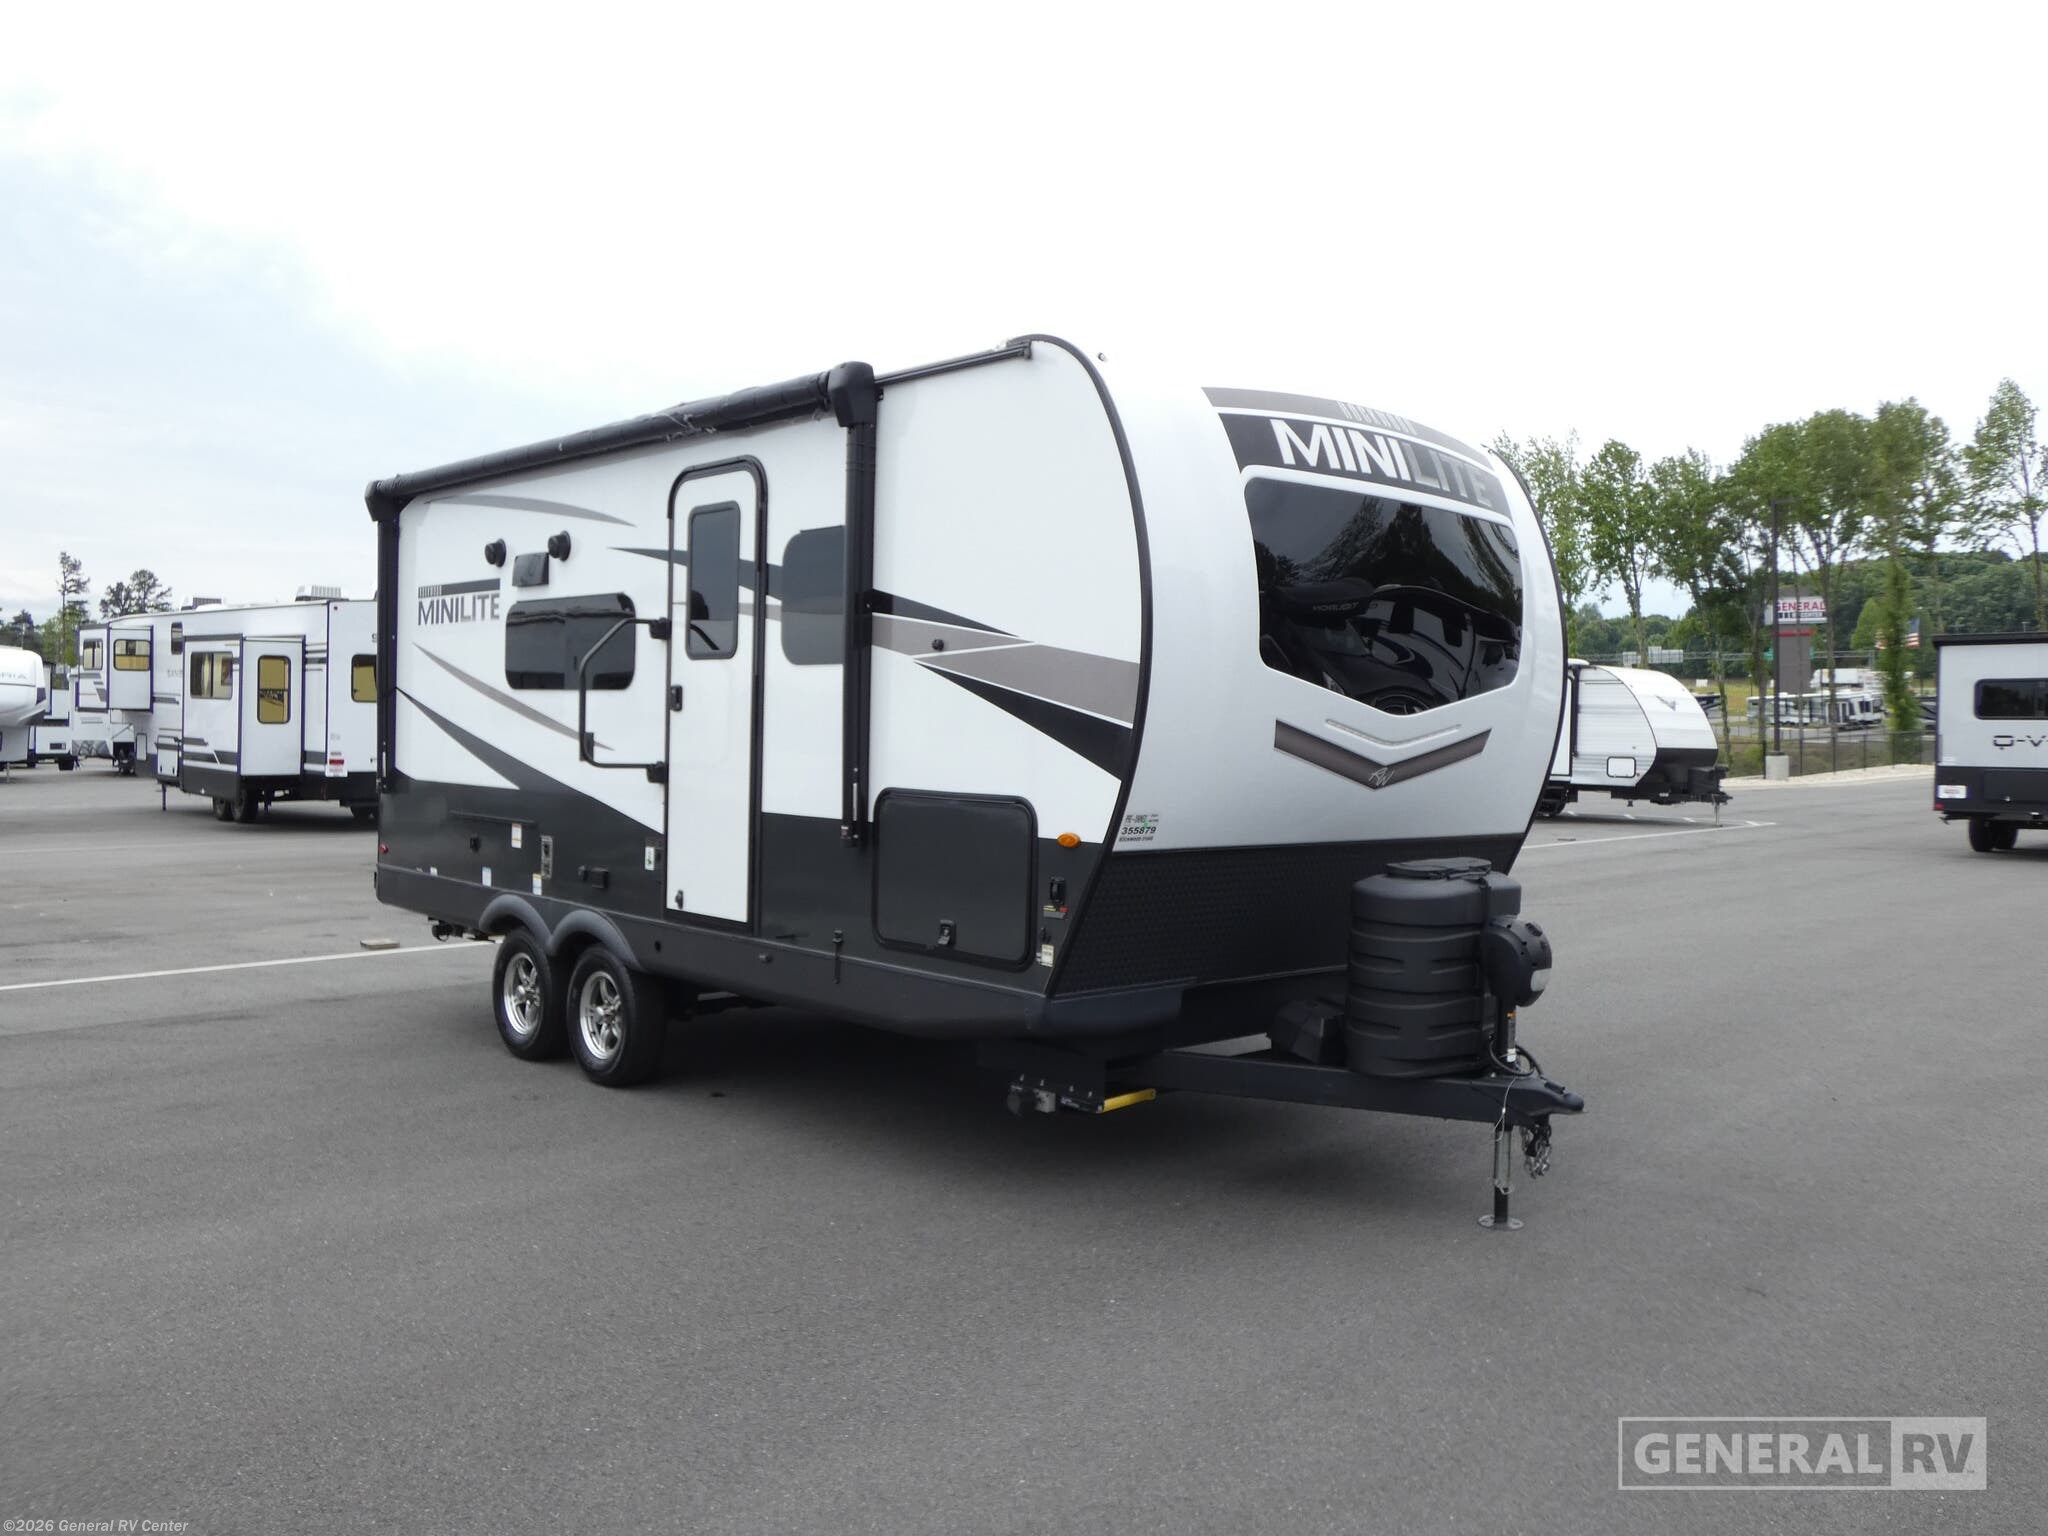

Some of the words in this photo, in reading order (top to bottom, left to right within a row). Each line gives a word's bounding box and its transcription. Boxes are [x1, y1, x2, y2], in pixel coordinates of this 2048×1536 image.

[1270, 418, 1493, 508] MINILITE
[418, 593, 500, 626] MINILITE
[1993, 735, 2048, 750] Q-V
[1121, 826, 1157, 835] 355879
